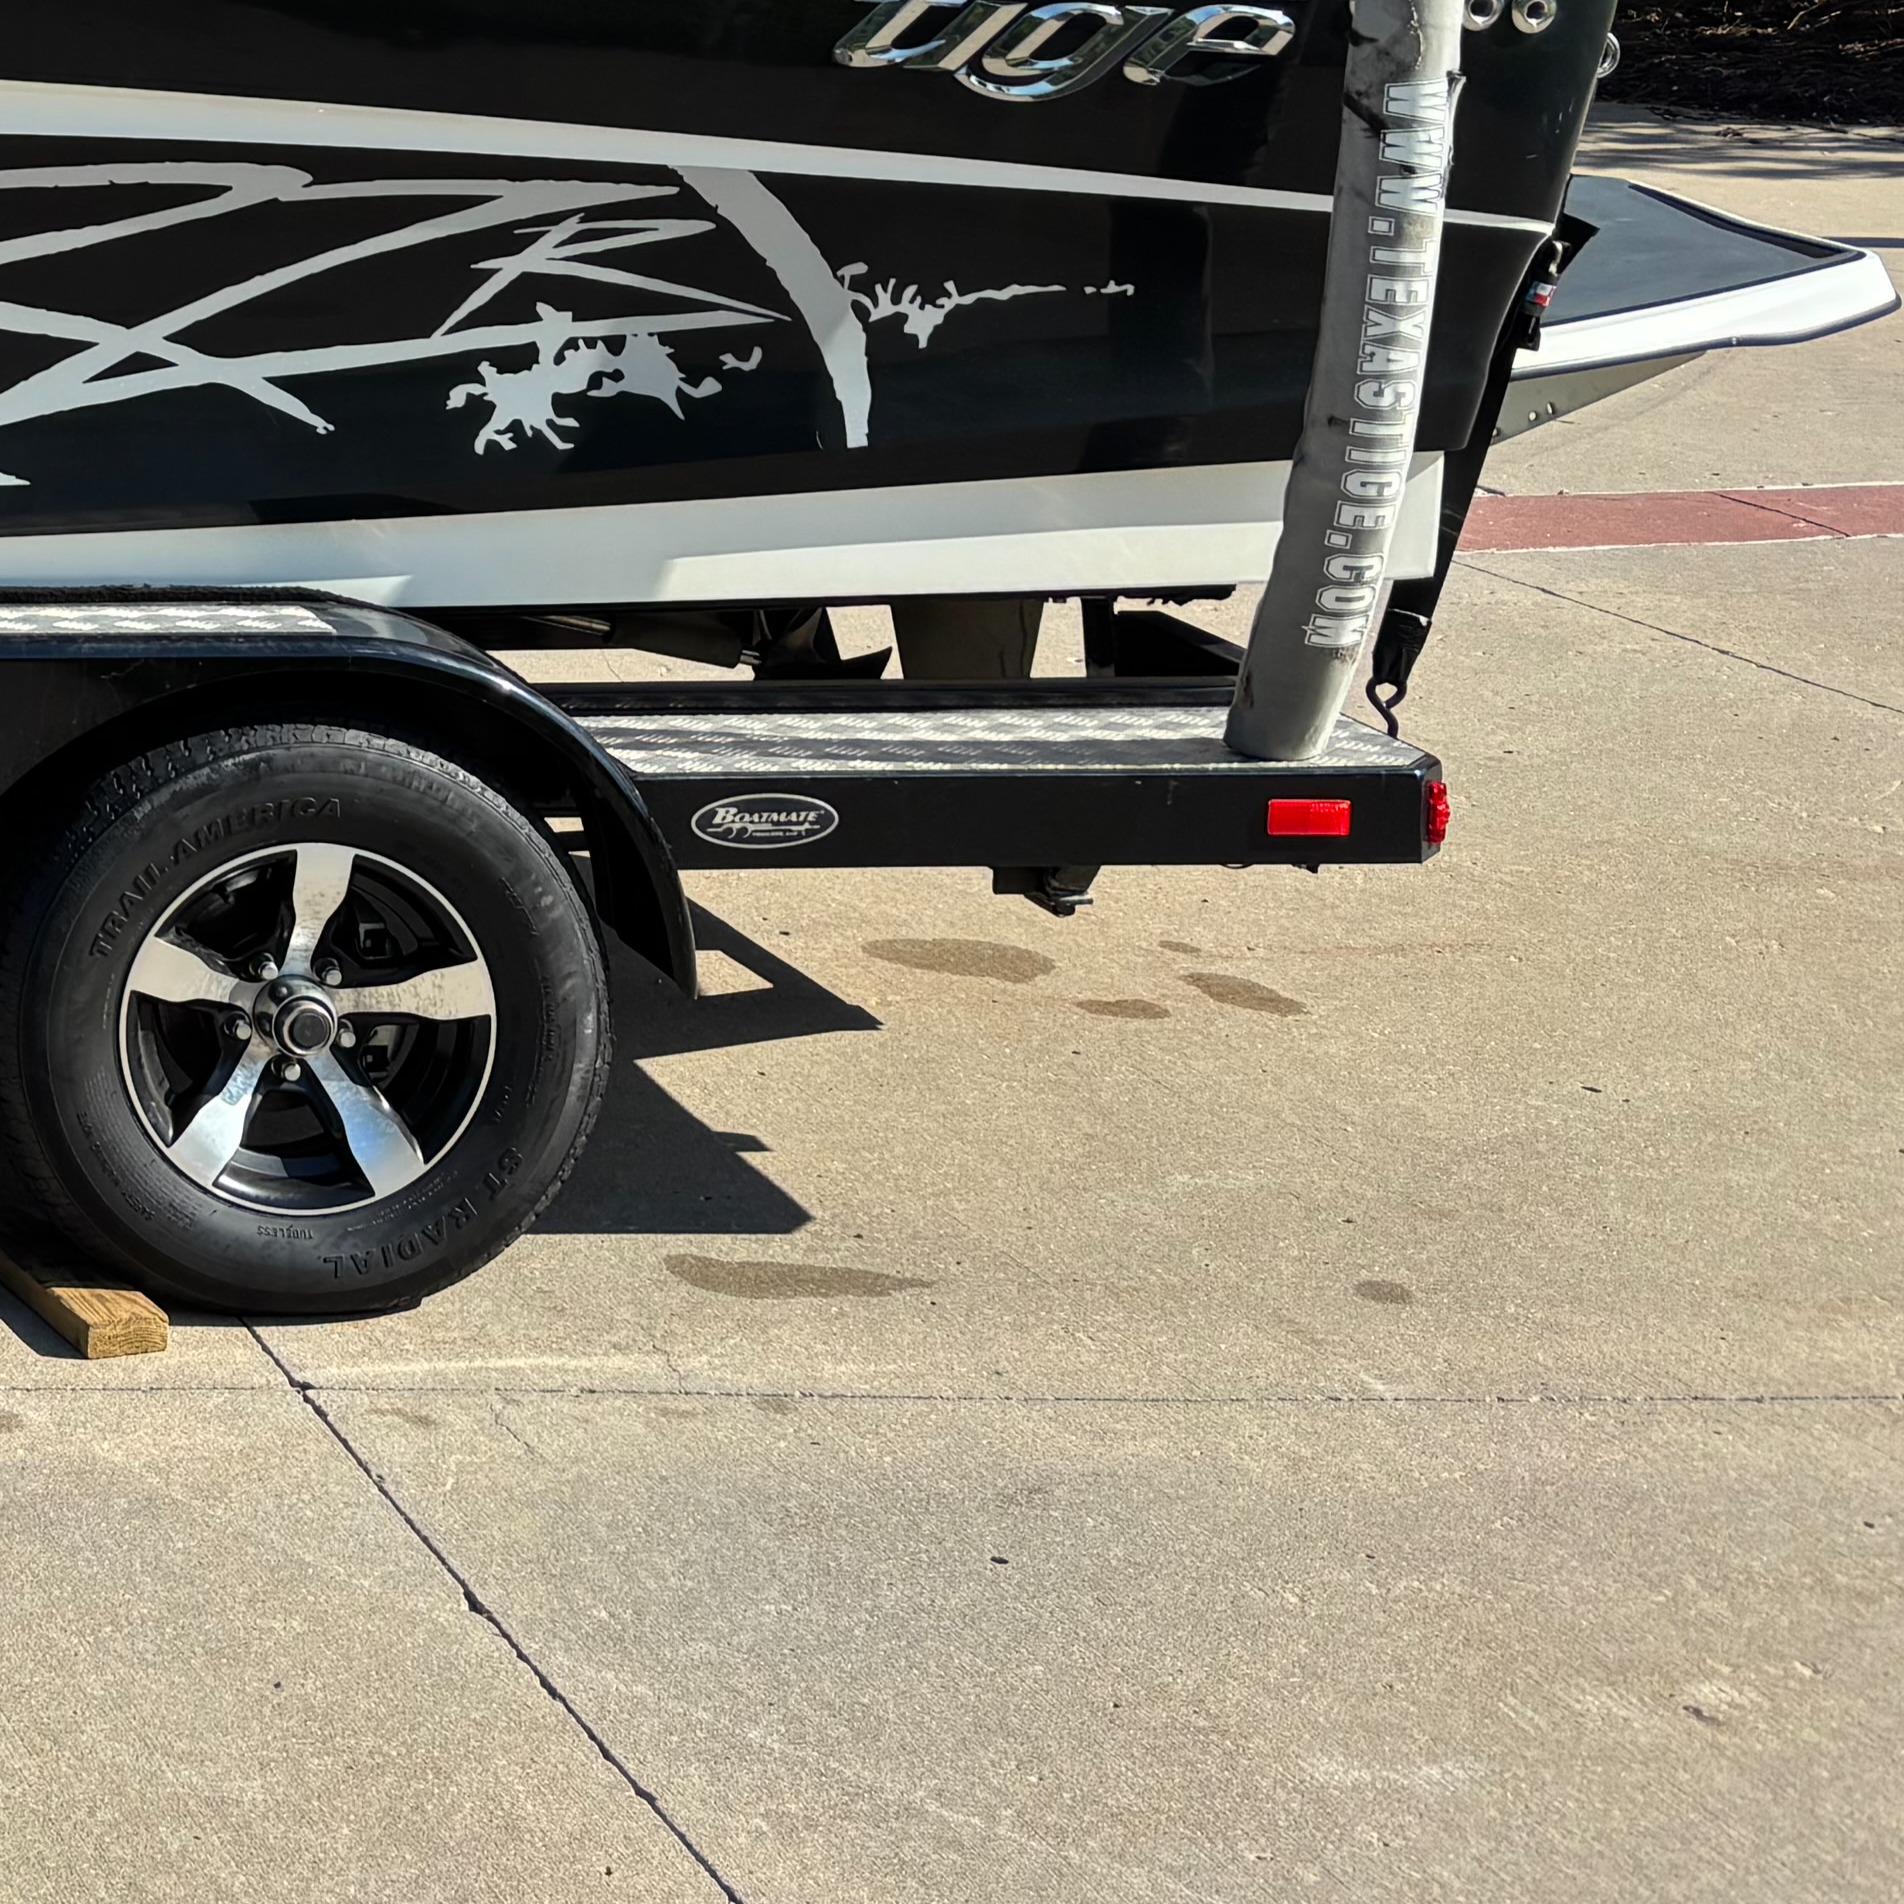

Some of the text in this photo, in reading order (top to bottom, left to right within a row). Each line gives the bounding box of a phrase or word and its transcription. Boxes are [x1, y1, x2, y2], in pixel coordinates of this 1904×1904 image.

[711, 807, 819, 824] BOATMATE
[86, 794, 347, 962] TRAIL AMERICA
[321, 1195, 483, 1283] RADIAL
